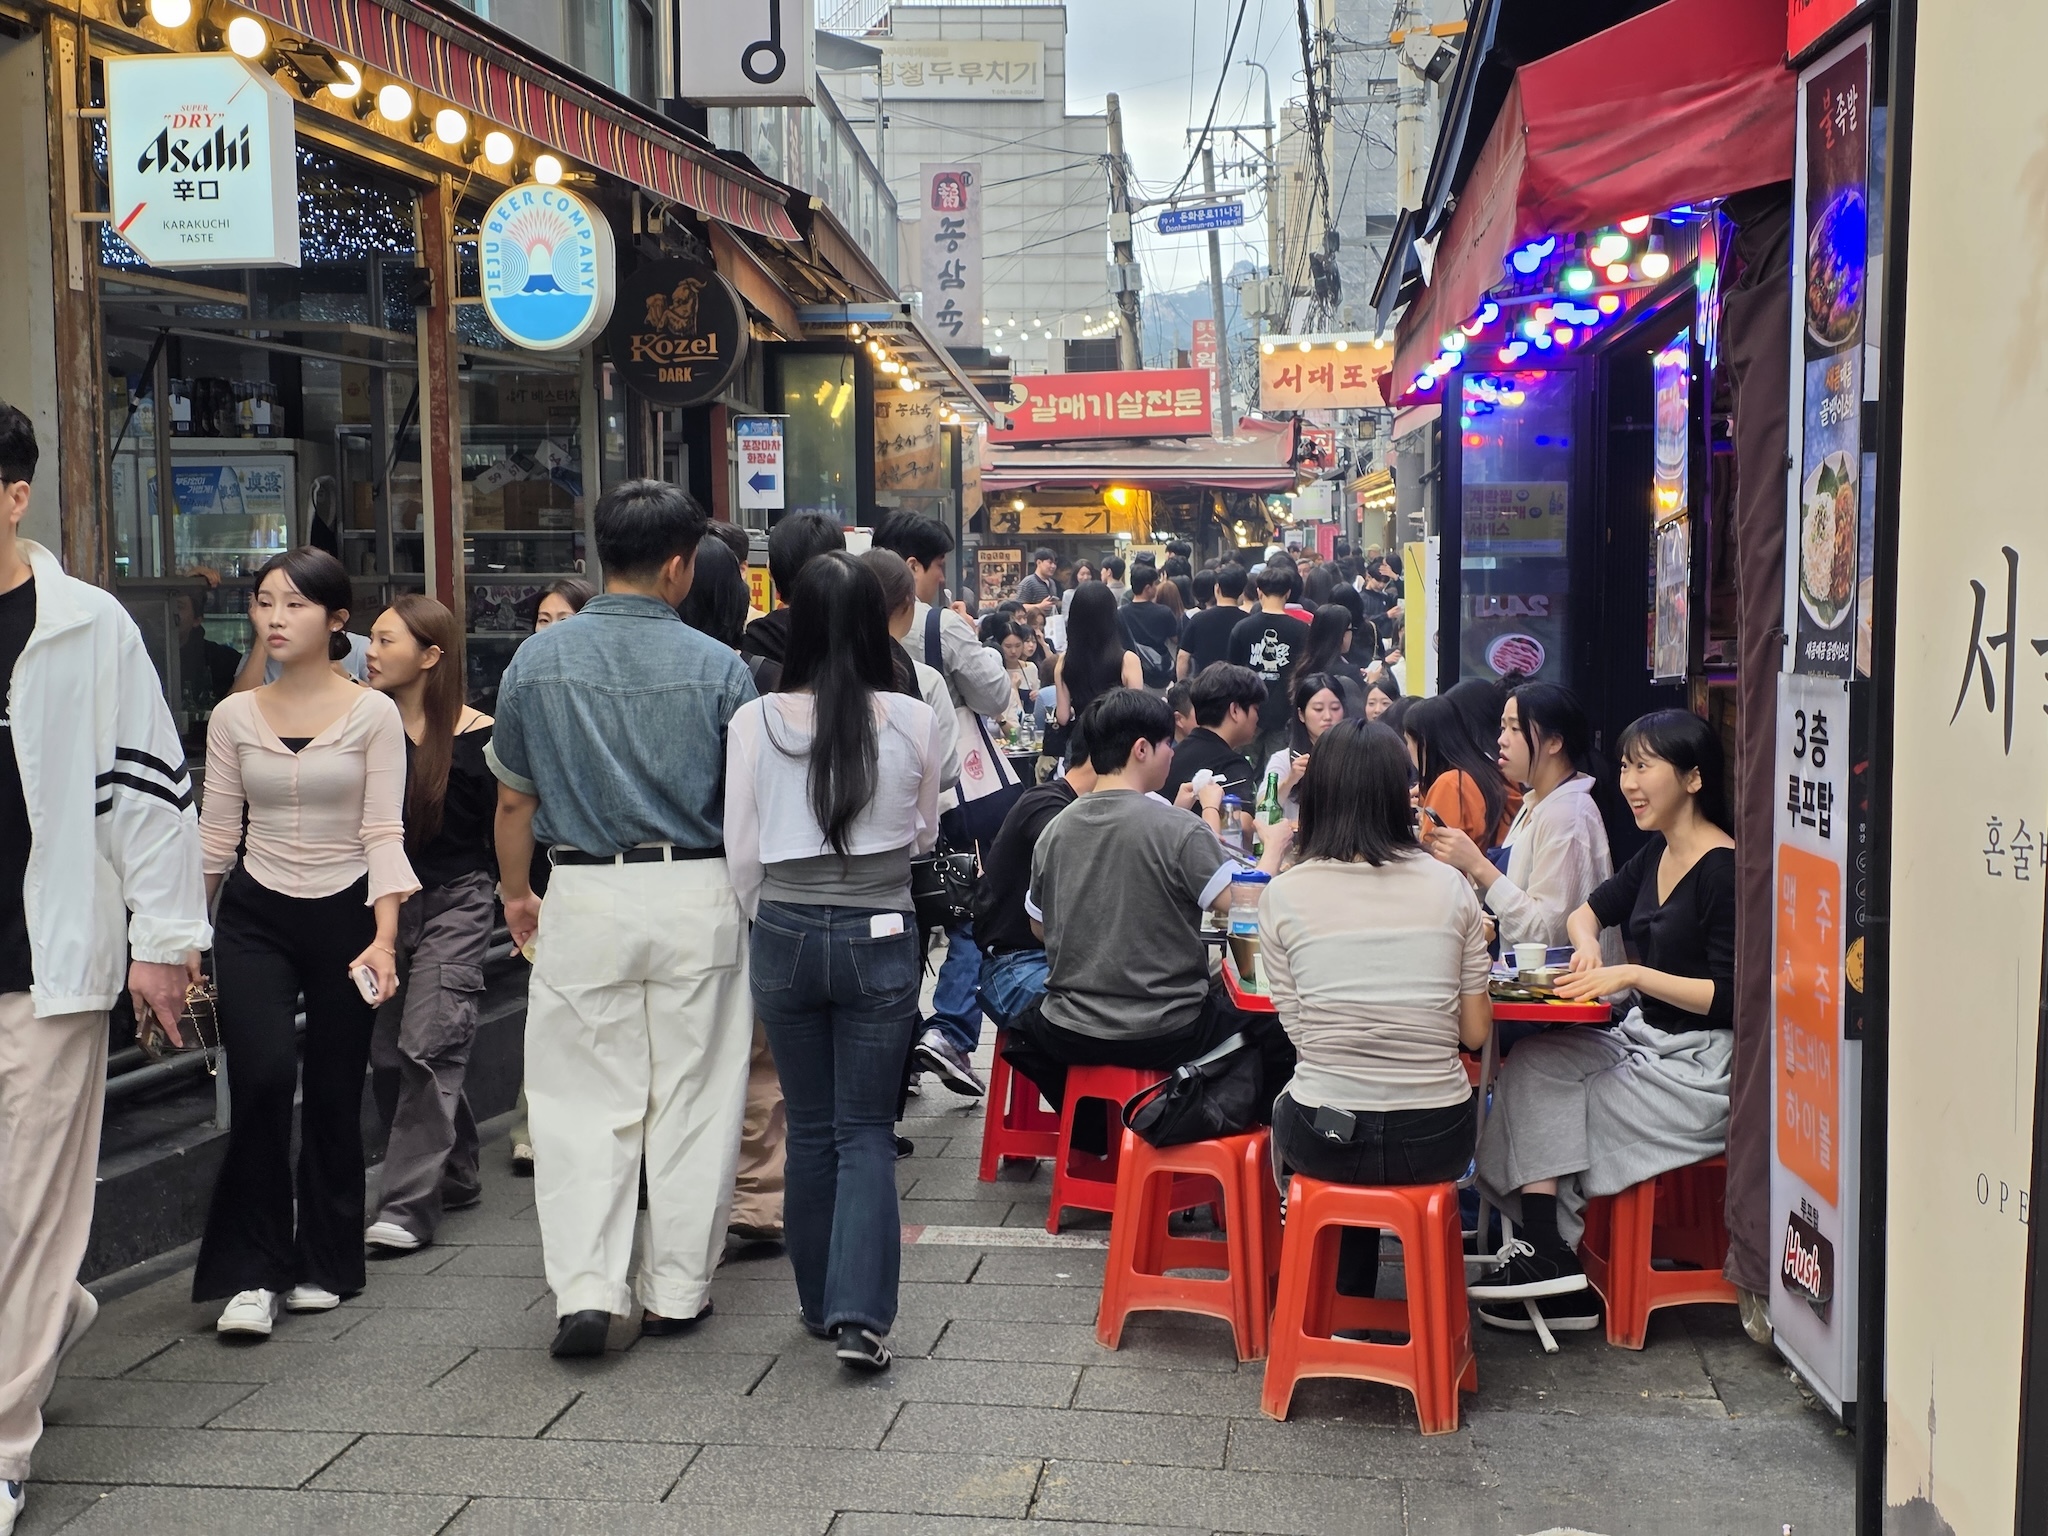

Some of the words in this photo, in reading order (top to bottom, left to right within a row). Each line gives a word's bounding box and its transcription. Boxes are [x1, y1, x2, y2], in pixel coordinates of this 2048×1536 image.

[180, 104, 208, 112] SUPER
[137, 123, 251, 174] Asahi
[173, 179, 219, 201] 辛口
[163, 219, 230, 230] KARAKUCHI
[488, 191, 534, 234] BEER
[1165, 222, 1215, 232] Donhwamun-ro
[1179, 205, 1242, 224] 돈화문로11나길
[180, 233, 214, 243] TASTE
[542, 191, 595, 290] COMPANY
[486, 242, 501, 292] JEJU
[934, 216, 966, 337] 종삼육
[630, 332, 718, 364] Kozel
[658, 367, 692, 382] DARK
[1030, 388, 1203, 423] 갈매기살전문
[742, 439, 781, 451] 포장마차
[747, 453, 776, 464] 화장실
[995, 509, 1112, 533] 생고기
[1793, 709, 1829, 768] 3층
[1787, 774, 1833, 840] 루프탑
[1784, 1089, 1831, 1171] 하이볼
[1800, 1197, 1819, 1231] 루프탑
[1784, 1224, 1821, 1298] Hush
